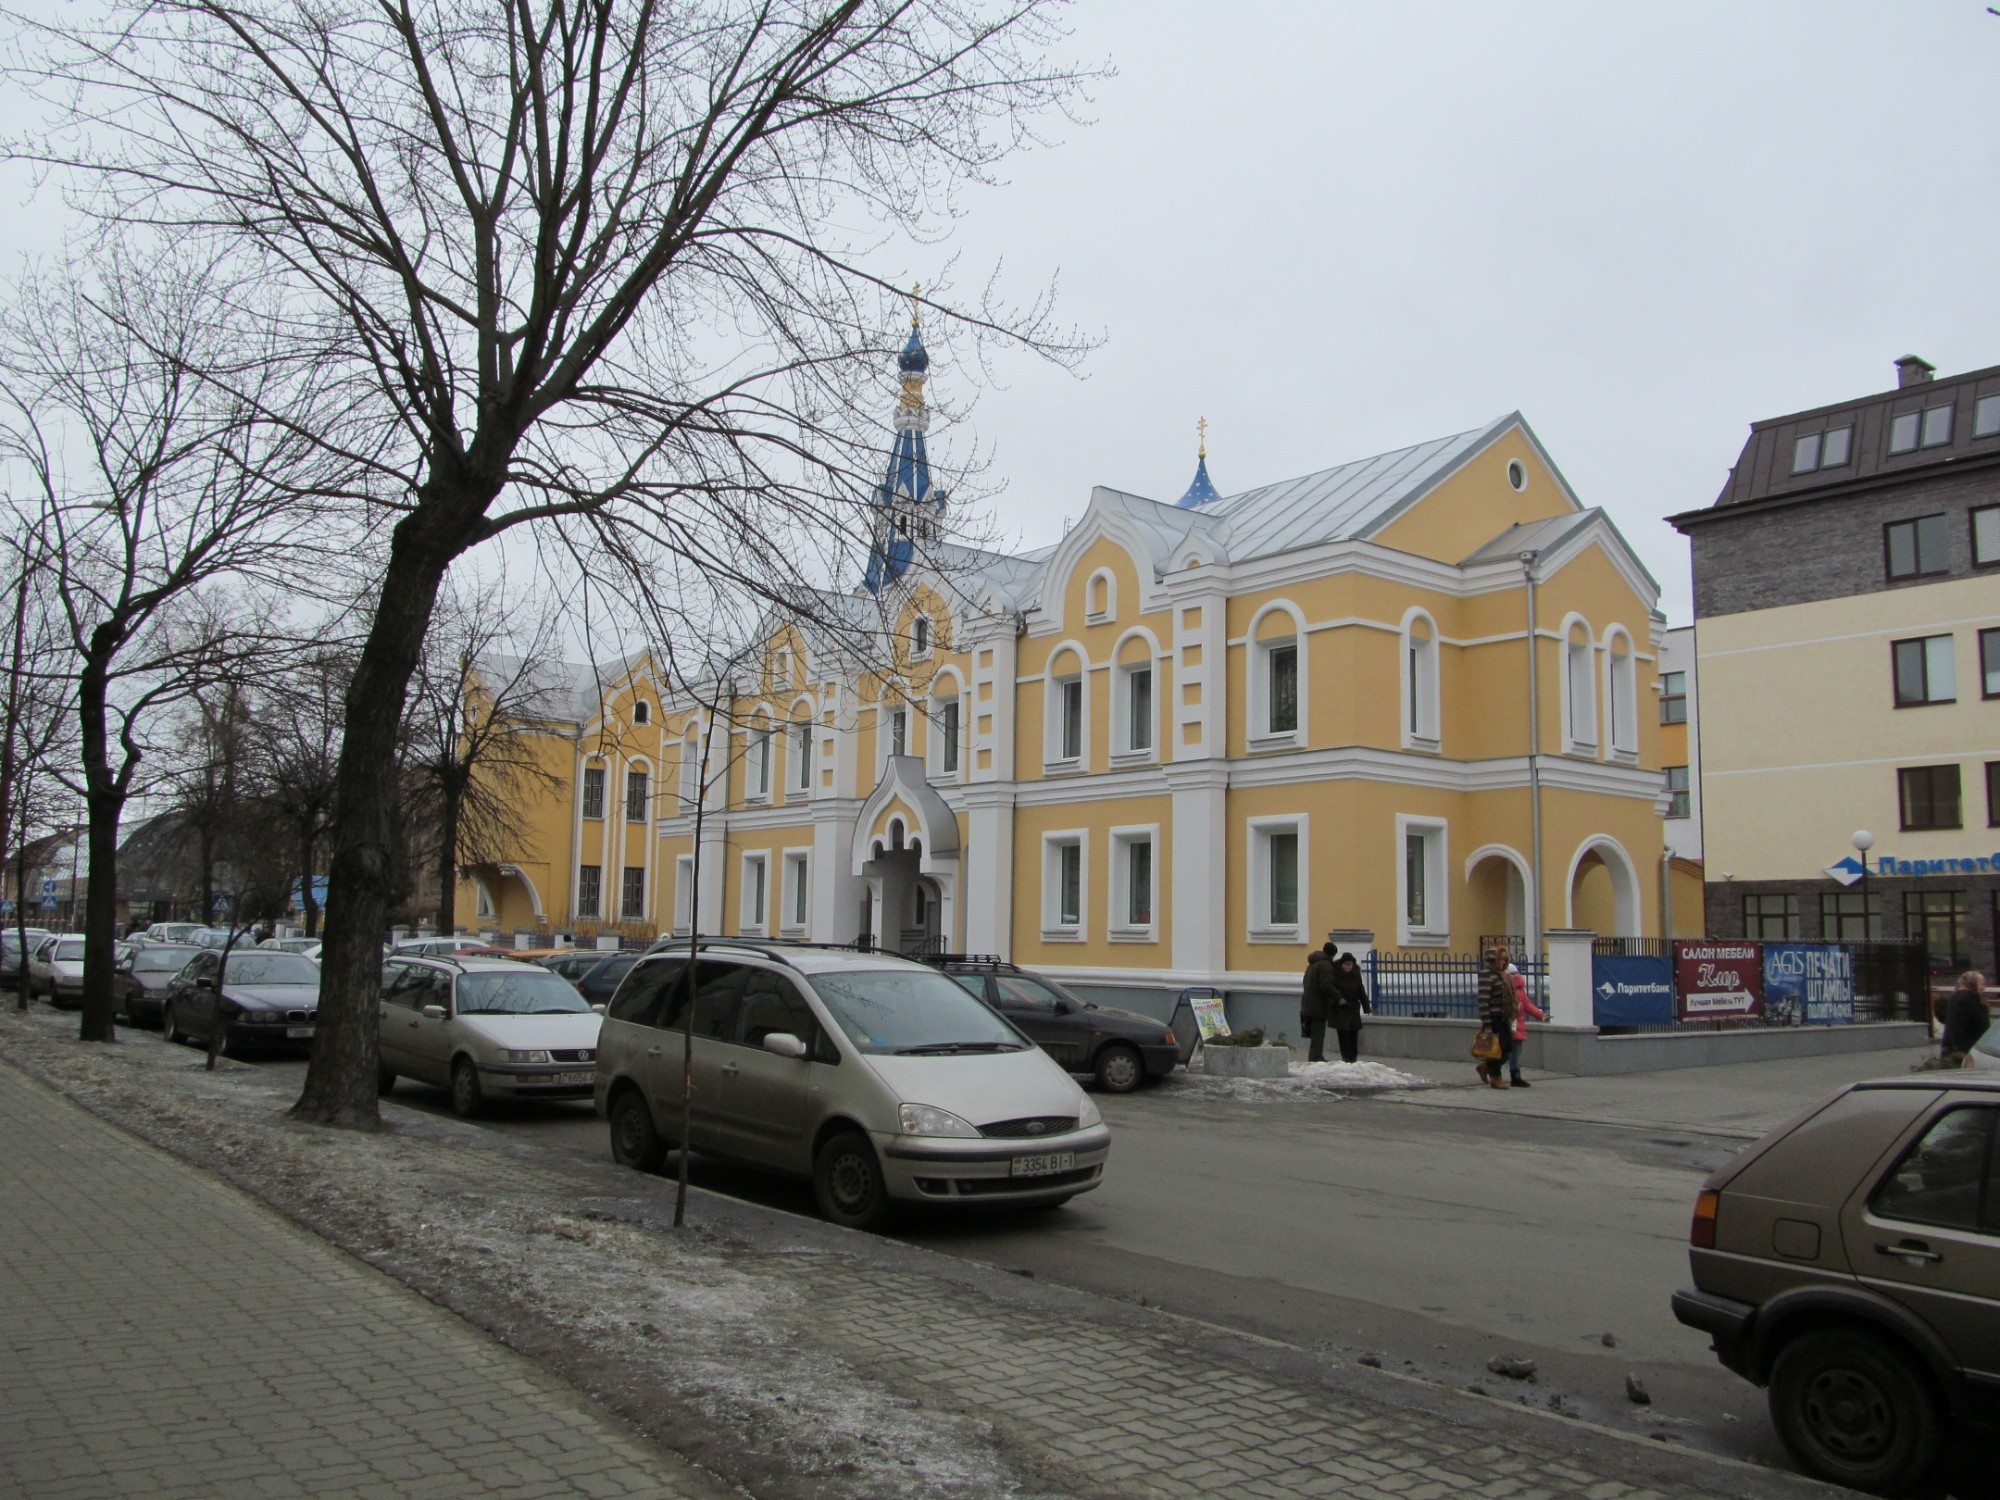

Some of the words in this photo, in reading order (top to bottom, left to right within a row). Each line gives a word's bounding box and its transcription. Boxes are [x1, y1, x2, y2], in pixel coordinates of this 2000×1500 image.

[1682, 947, 1715, 959] САЛОН
[1716, 947, 1755, 959] МЕБЕЛИ
[1806, 951, 1850, 978] ПЕЧАТИ
[1617, 982, 1671, 996] Паритетбанк
[1807, 979, 1851, 1002] ШТАМПЫ
[1734, 996, 1745, 1005] ТУТ
[1807, 1003, 1852, 1019] ПОЛИГРАФИЯ
[1023, 1157, 1047, 1172] 3354
